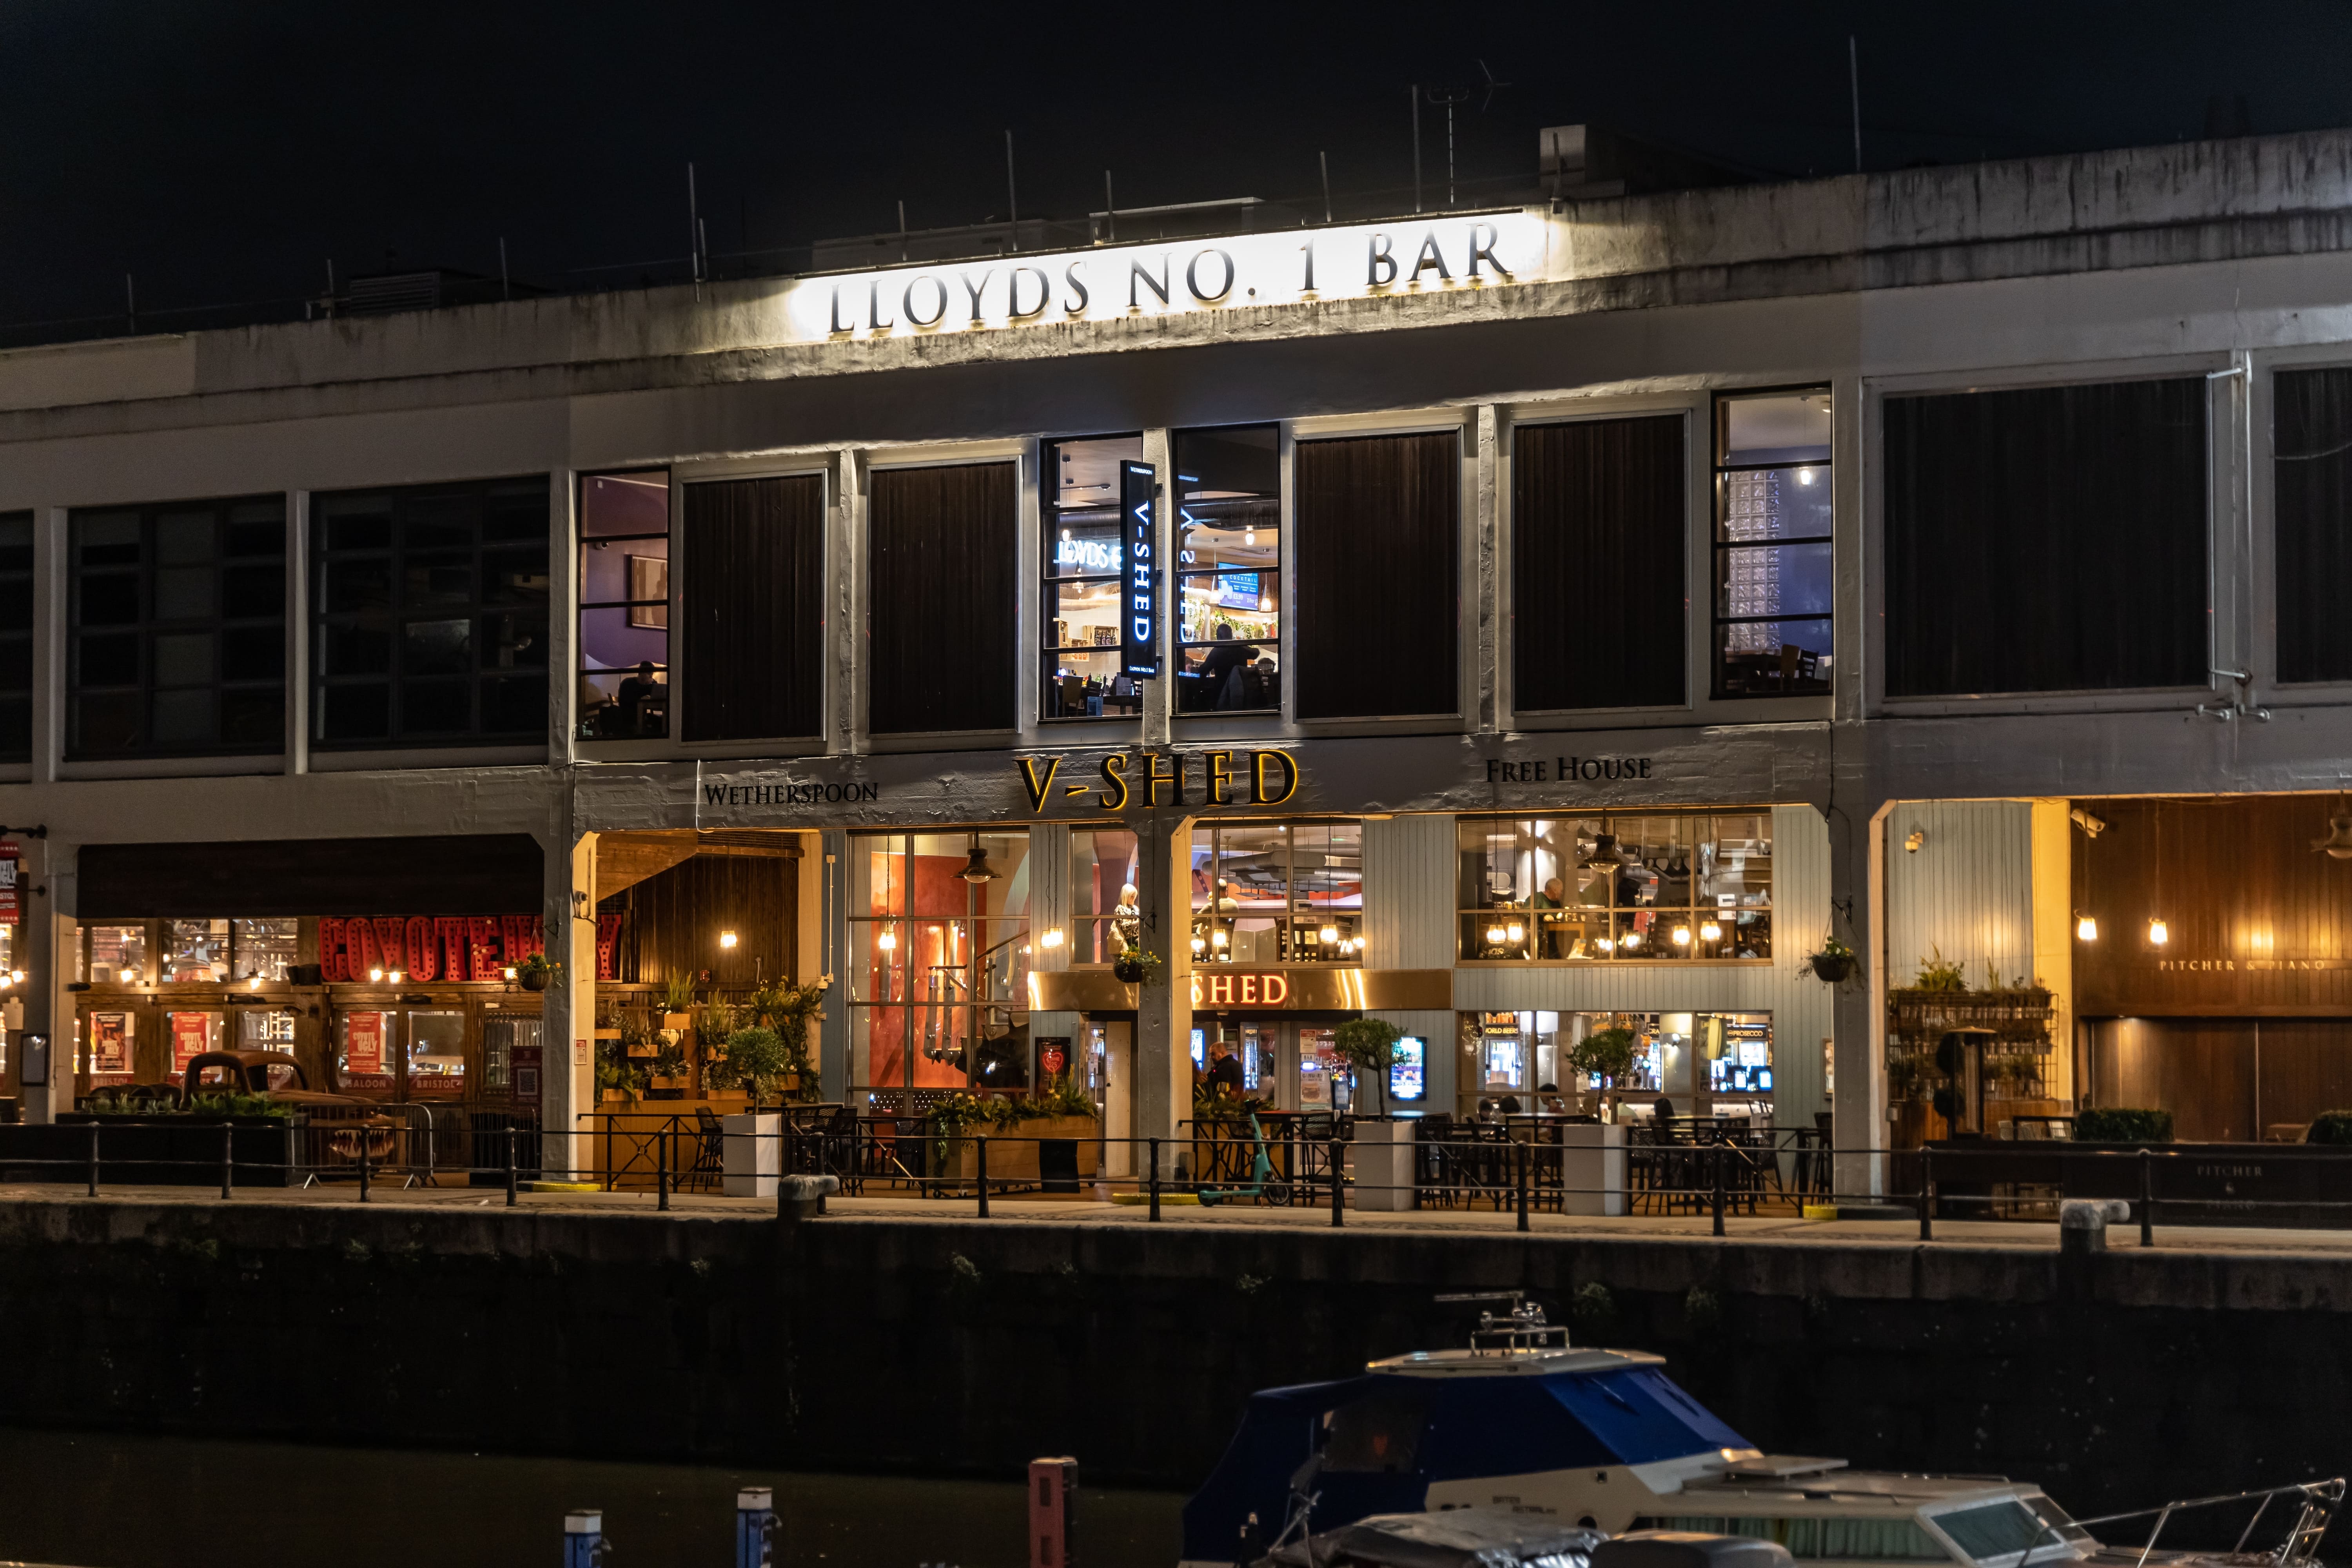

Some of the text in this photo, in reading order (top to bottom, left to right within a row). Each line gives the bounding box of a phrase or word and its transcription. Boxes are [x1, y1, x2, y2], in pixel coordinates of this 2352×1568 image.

[827, 221, 1514, 333] LLOYDS NO. 1 BAR
[1134, 500, 1150, 642] V-SHED
[1012, 750, 1299, 813] V-SHED
[1485, 757, 1651, 782] FREE HOUSE
[705, 782, 878, 806] WETHERSPOON
[319, 916, 509, 982] COYOTE
[2159, 960, 2325, 971] PITCHER & PIANO
[1191, 975, 1288, 1004] SHED
[416, 1080, 455, 1088] BRISTOL
[2197, 1165, 2262, 1177] PITCHER
